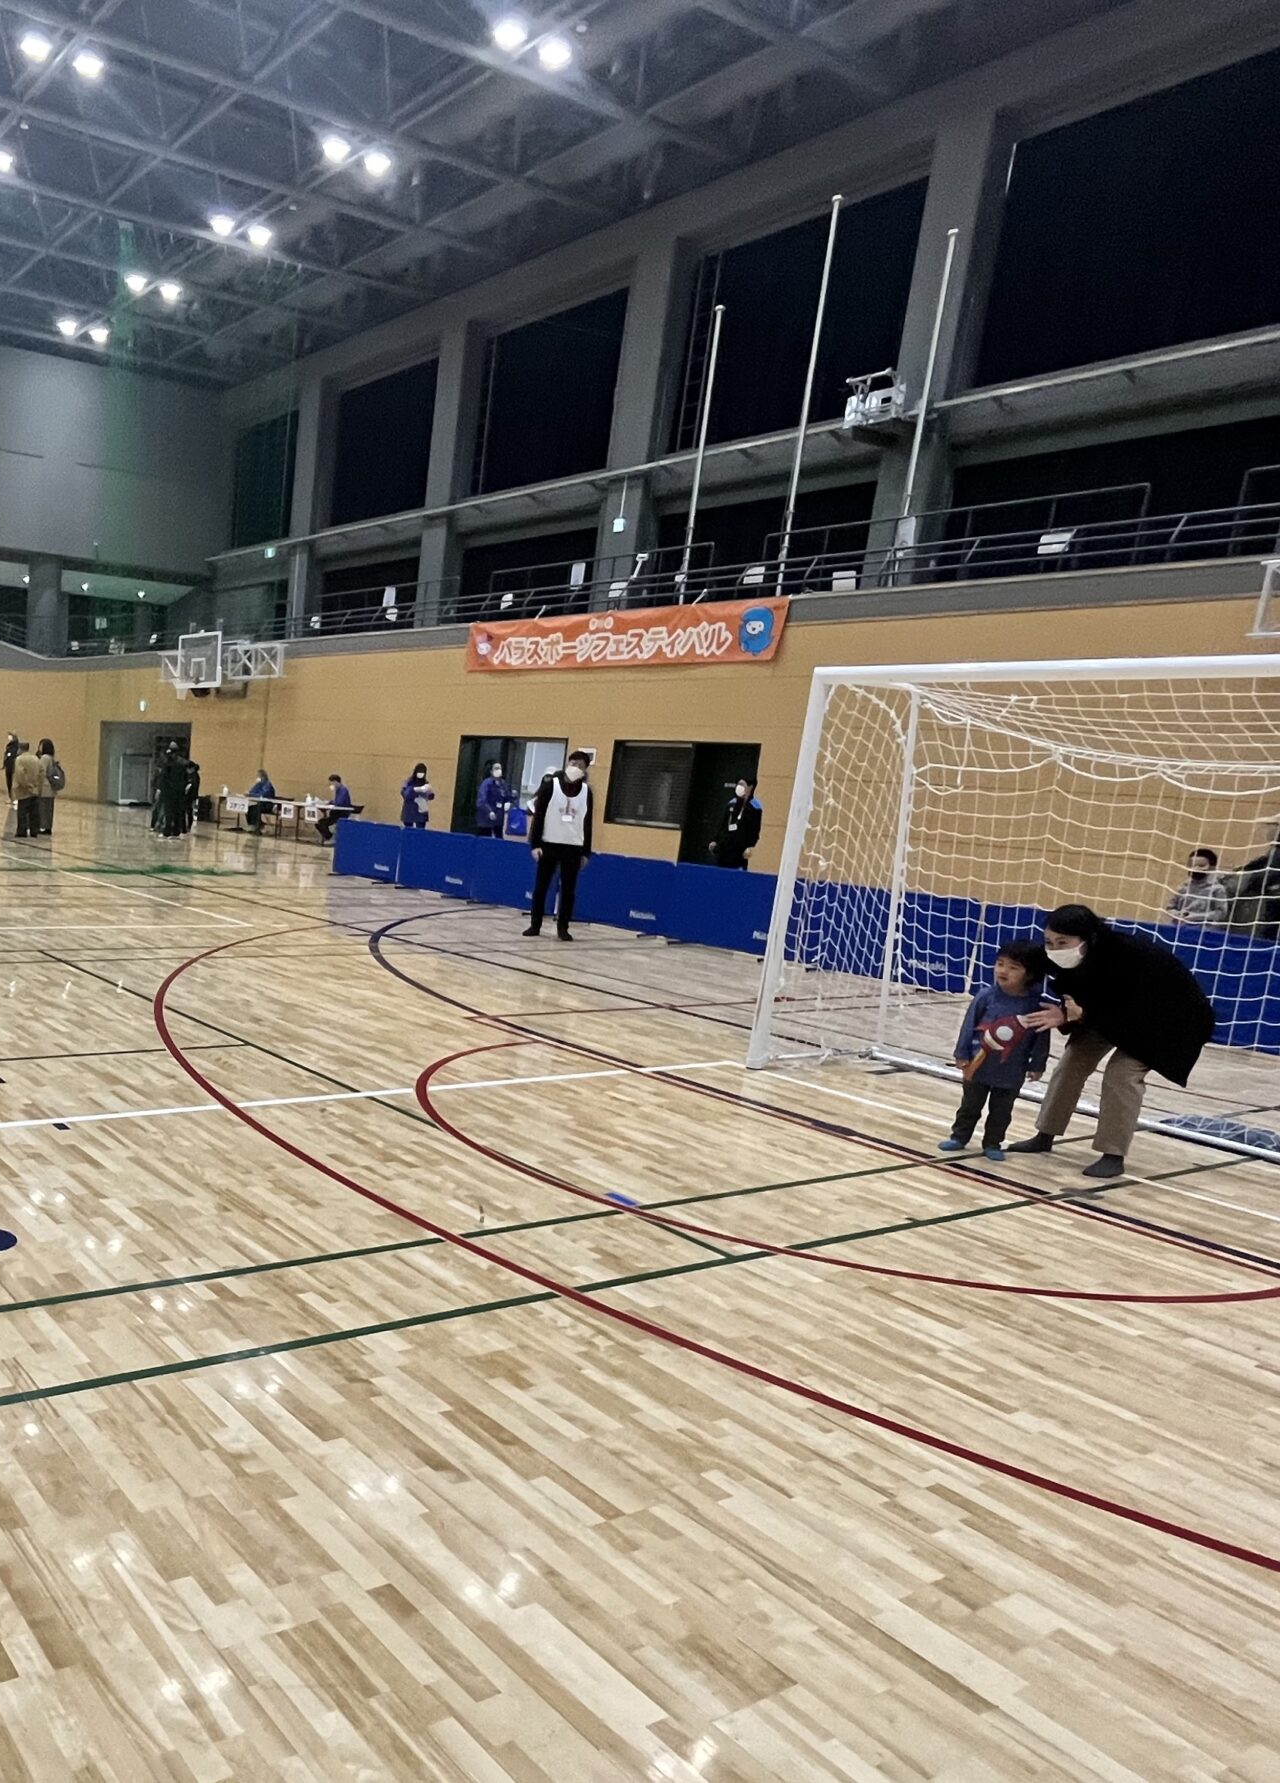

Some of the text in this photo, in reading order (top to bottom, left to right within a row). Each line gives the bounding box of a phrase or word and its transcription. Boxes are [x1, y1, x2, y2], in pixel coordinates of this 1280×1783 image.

[493, 622, 733, 665] パラスポーツフェスティバル
